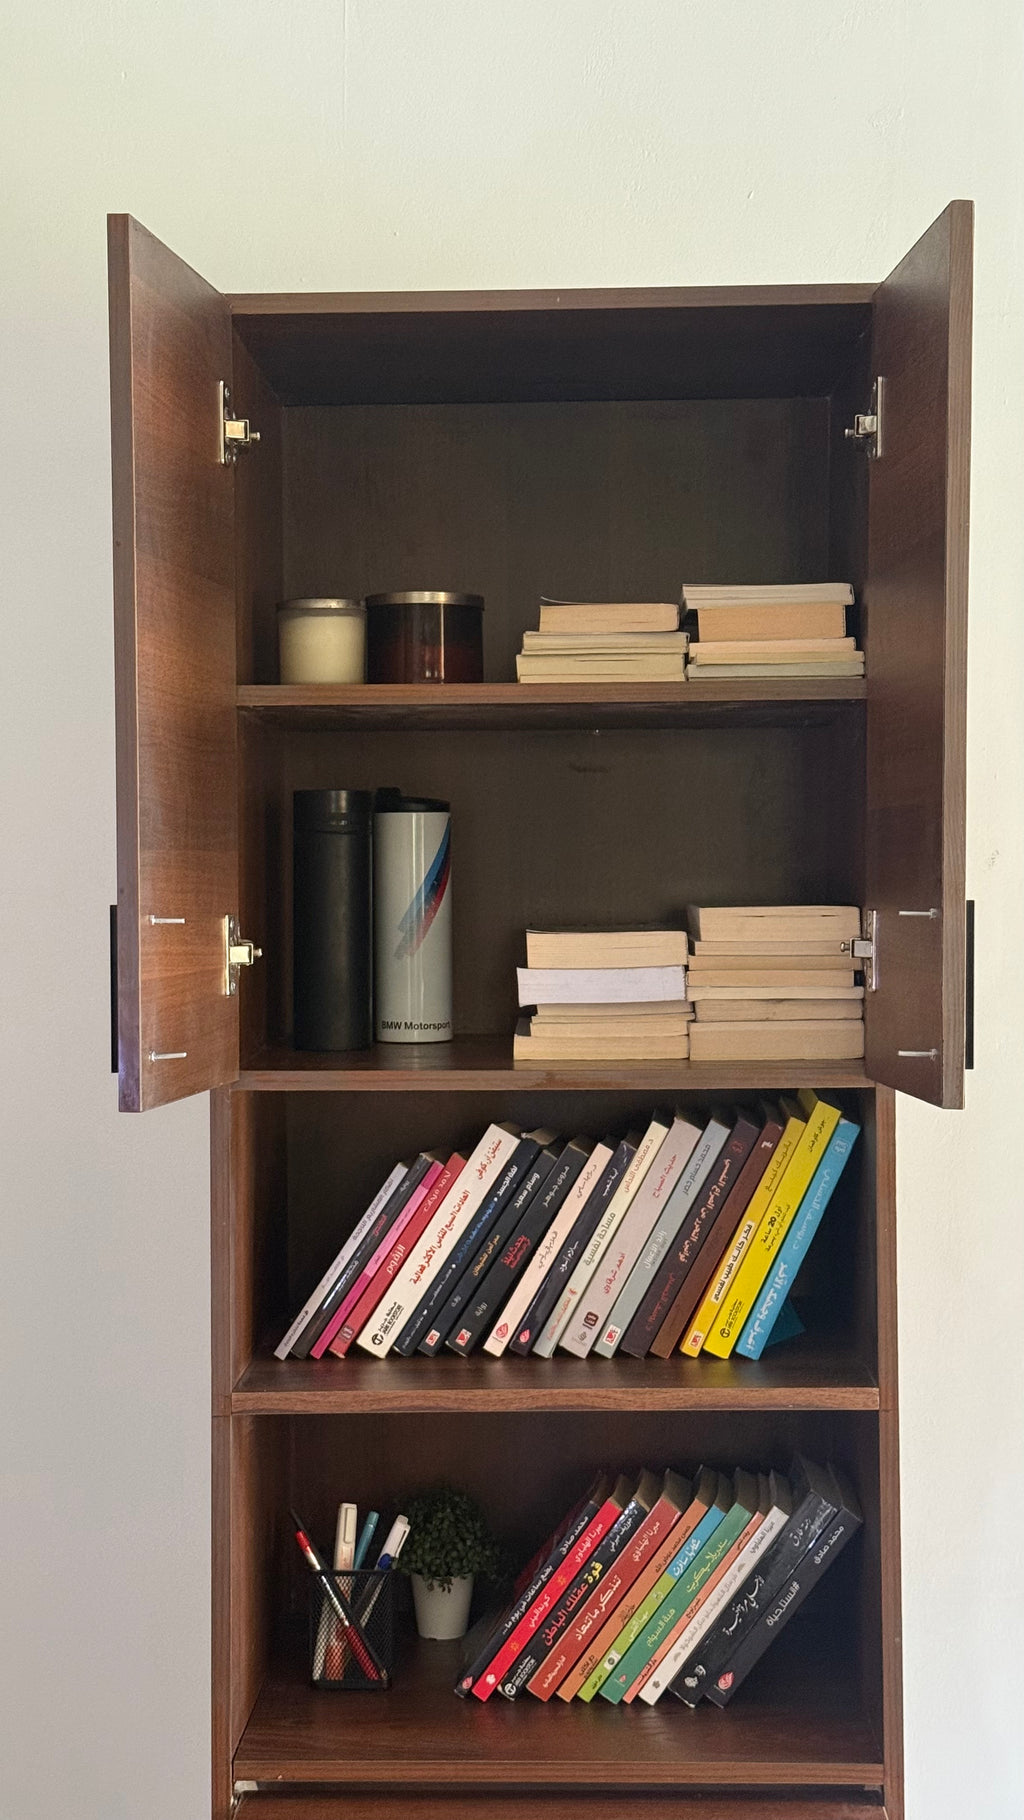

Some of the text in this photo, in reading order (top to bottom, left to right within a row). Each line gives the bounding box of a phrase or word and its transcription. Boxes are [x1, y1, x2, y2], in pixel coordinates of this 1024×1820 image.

[381, 1020, 450, 1031] BMW Motorsport
[633, 1144, 650, 1171] مصطفى
[697, 1143, 711, 1162] محمد
[622, 1170, 636, 1193] النحاس
[651, 1153, 677, 1198] حديث الصباح
[688, 1162, 702, 1182] حسام
[496, 1175, 511, 1196] الجسد
[513, 1172, 540, 1208] وسام سعيد
[542, 1184, 559, 1207] جوهر
[688, 1218, 703, 1241] التحرر
[705, 1184, 721, 1209] الصراع
[716, 1158, 733, 1186] النفسي
[409, 1189, 469, 1284] العادات السبع للناس الأكثر فعالية
[582, 1211, 616, 1266] مساحة نفسية
[557, 1240, 579, 1272] سلام أسود
[722, 1262, 734, 1279] طبيب
[756, 1287, 778, 1320] وجهك
[772, 1262, 789, 1289] الآخر
[474, 1301, 487, 1316] رواية
[559, 1515, 589, 1554] محمد صادق
[573, 1522, 603, 1562] ميرنا الهلباوي
[630, 1520, 660, 1562] ميرنا الهلباوي
[788, 1526, 805, 1547] طارق
[812, 1544, 830, 1564] صادق
[540, 1565, 553, 1581] بضع
[582, 1560, 603, 1584] قوة
[524, 1579, 542, 1602] ساعات
[564, 1581, 588, 1611] عقلك
[510, 1610, 522, 1622] يوم
[527, 1594, 551, 1627] كونداليني
[661, 1607, 675, 1622] هبة
[737, 1598, 753, 1611] مرة
[540, 1608, 569, 1646] الباطن
[720, 1603, 744, 1635] أخيرة
